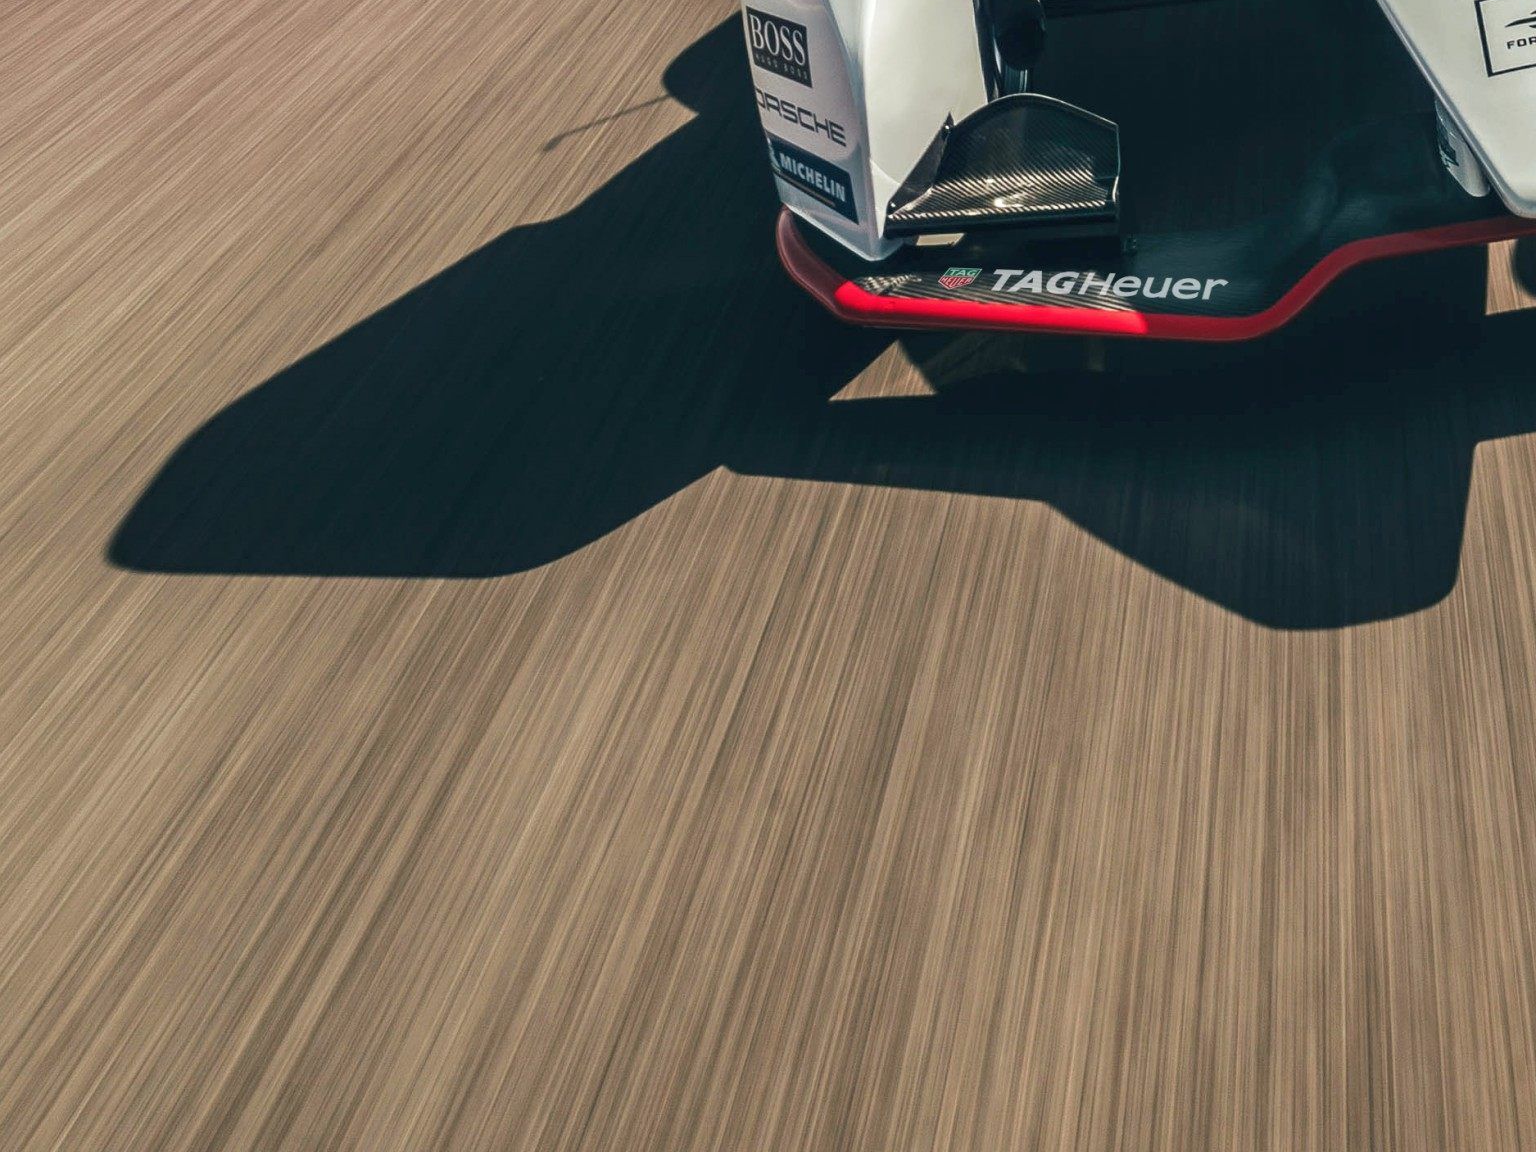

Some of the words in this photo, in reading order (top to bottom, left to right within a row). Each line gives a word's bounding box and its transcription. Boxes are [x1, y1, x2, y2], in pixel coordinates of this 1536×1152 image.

[749, 13, 806, 66] BOSS
[779, 152, 846, 202] MICHELIN
[938, 275, 975, 288] HEUER
[947, 268, 978, 277] TAG
